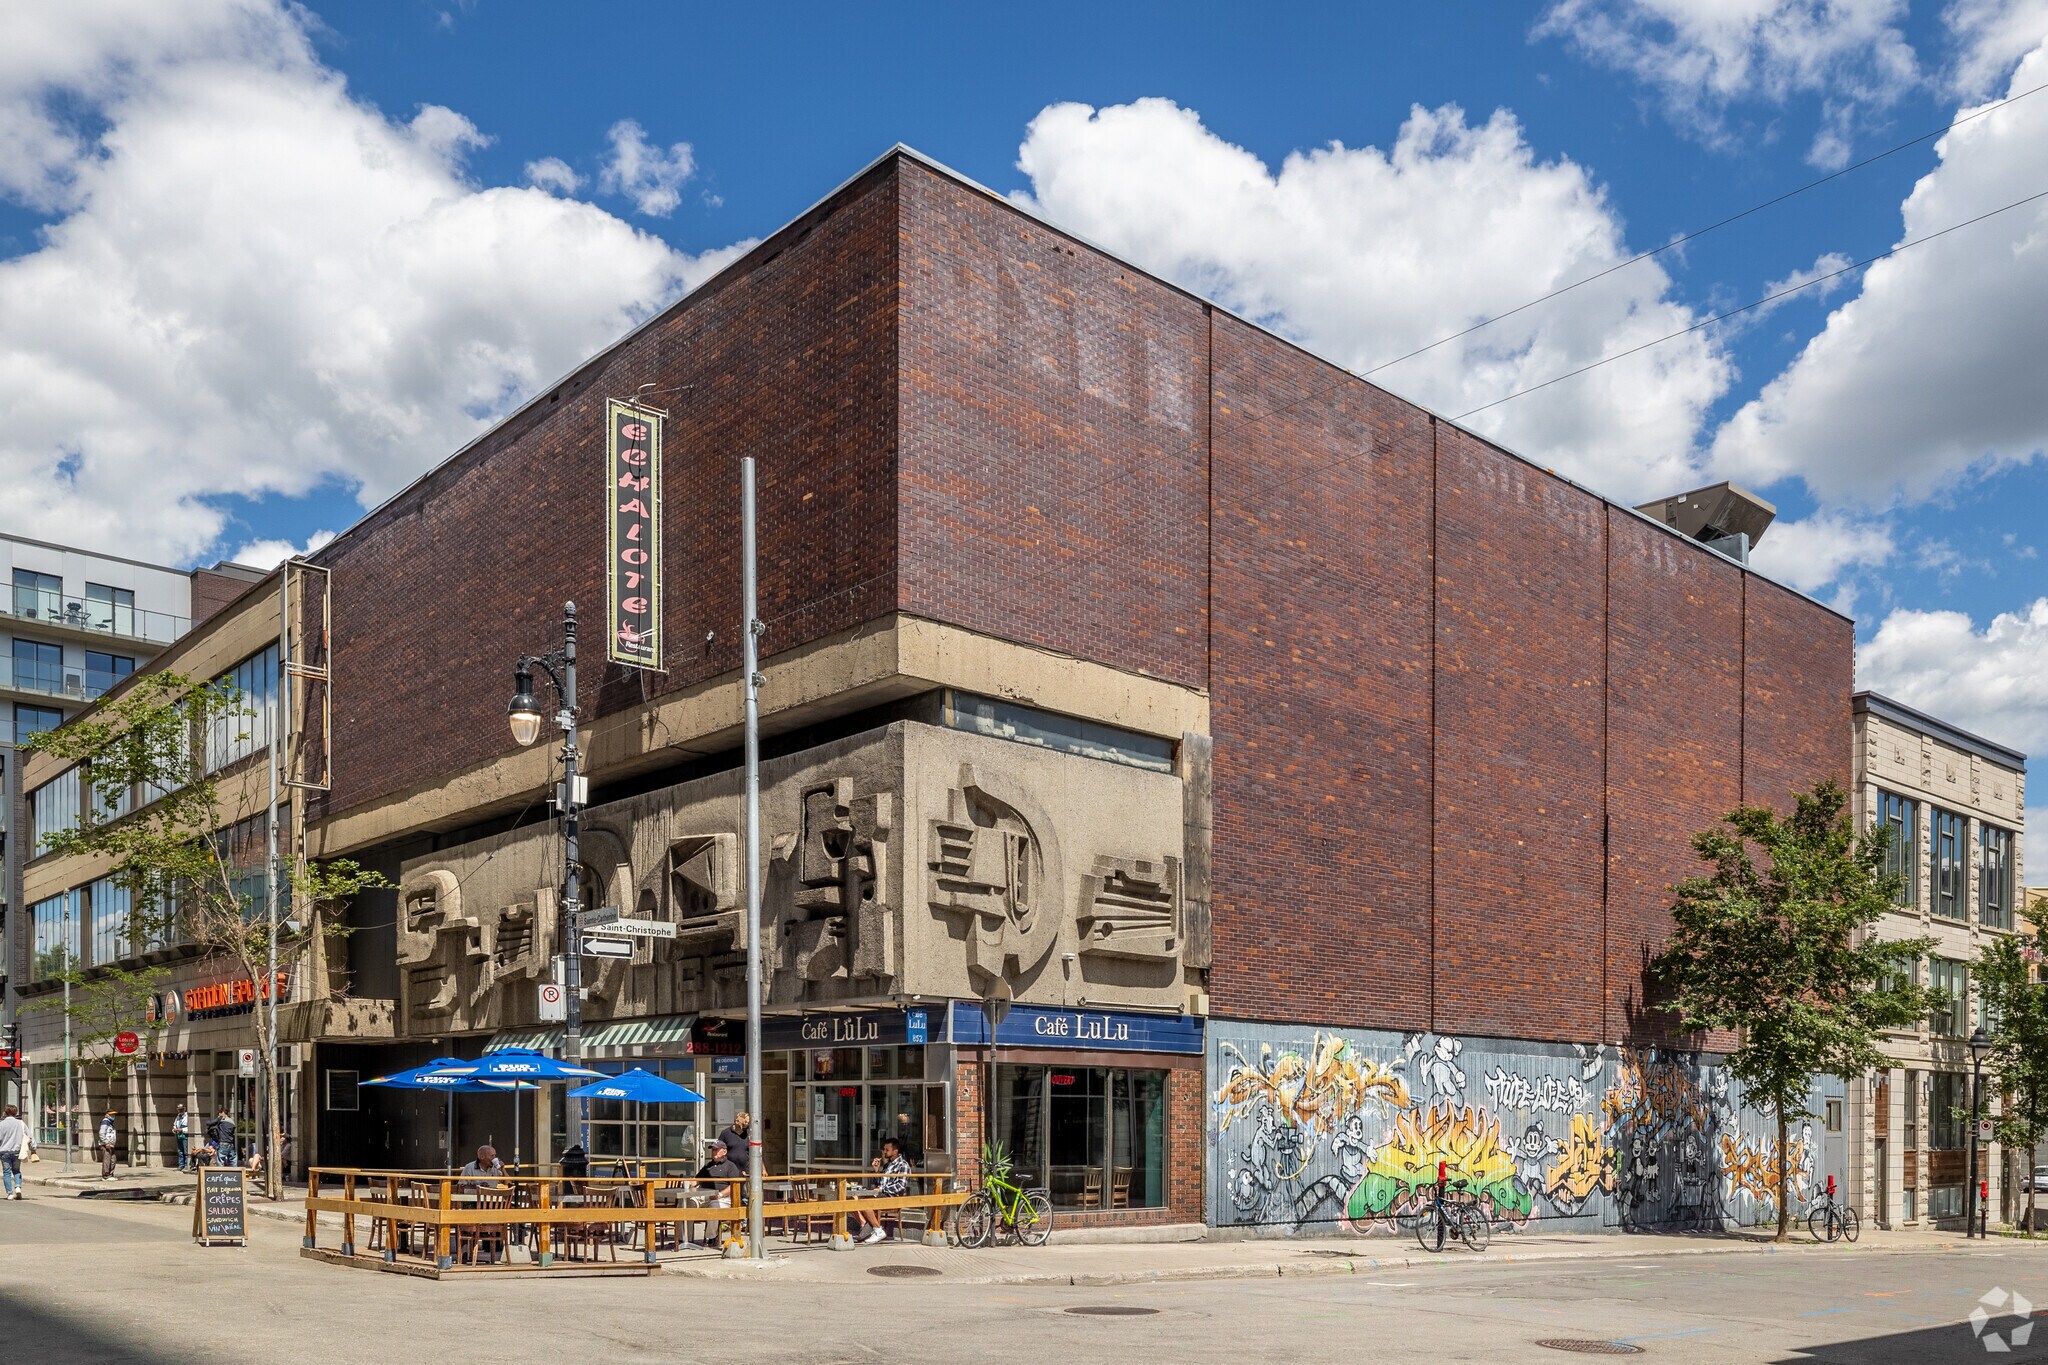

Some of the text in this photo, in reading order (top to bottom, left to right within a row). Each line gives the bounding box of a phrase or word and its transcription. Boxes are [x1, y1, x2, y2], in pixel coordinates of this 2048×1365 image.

[625, 640, 656, 653] Resturant
[600, 923, 672, 937] Saint-Christophe
[185, 983, 229, 1011] STATION
[801, 1016, 879, 1042] Café LuLu
[908, 1019, 926, 1029] LuLu
[1034, 1014, 1129, 1041] Café LuLu
[912, 1034, 924, 1043] 852
[686, 1041, 741, 1054] 288-1212
[1051, 1075, 1075, 1085] OUVERT
[209, 1193, 241, 1204] CRÊPES
[208, 1207, 239, 1215] SALADES
